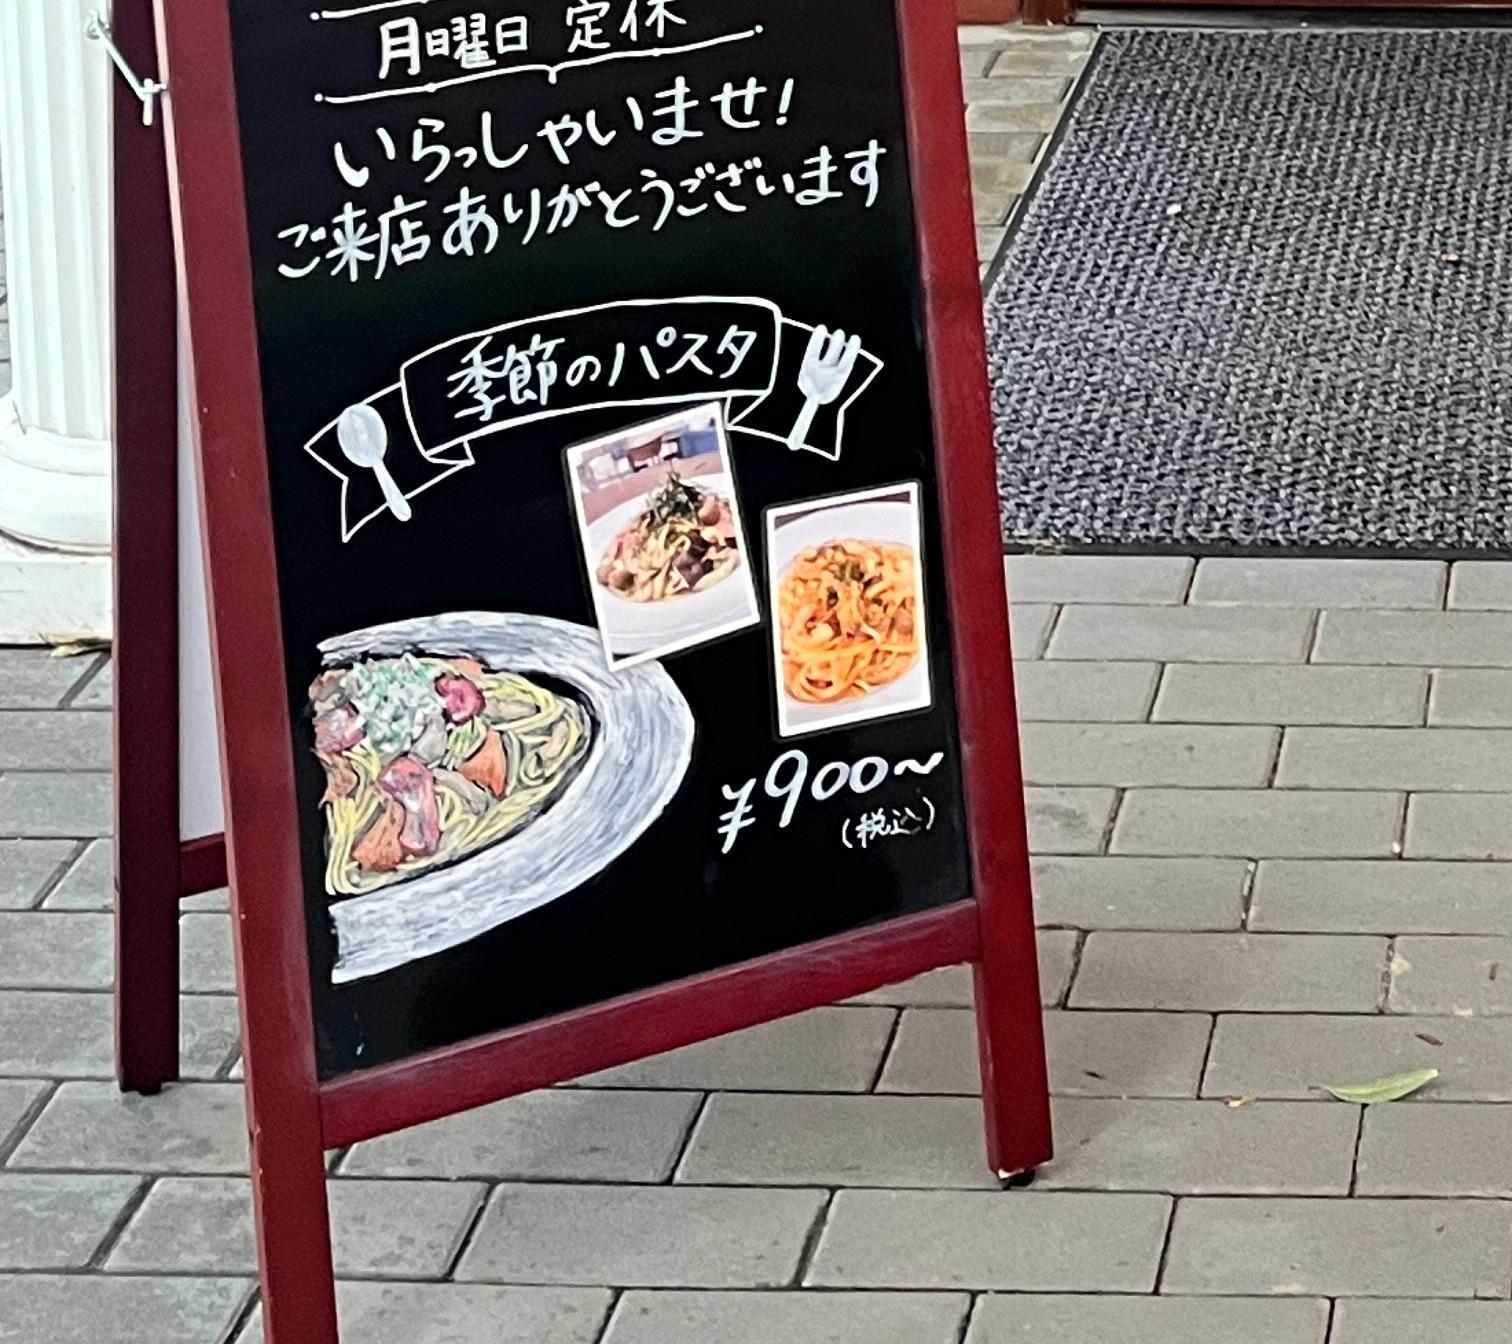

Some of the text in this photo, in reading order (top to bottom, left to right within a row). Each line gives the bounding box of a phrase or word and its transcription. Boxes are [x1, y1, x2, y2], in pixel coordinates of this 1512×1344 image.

[378, 12, 529, 80] 月曜日
[277, 139, 888, 280] ご来店ありがとうございます
[446, 324, 758, 422] 季節のパスタ
